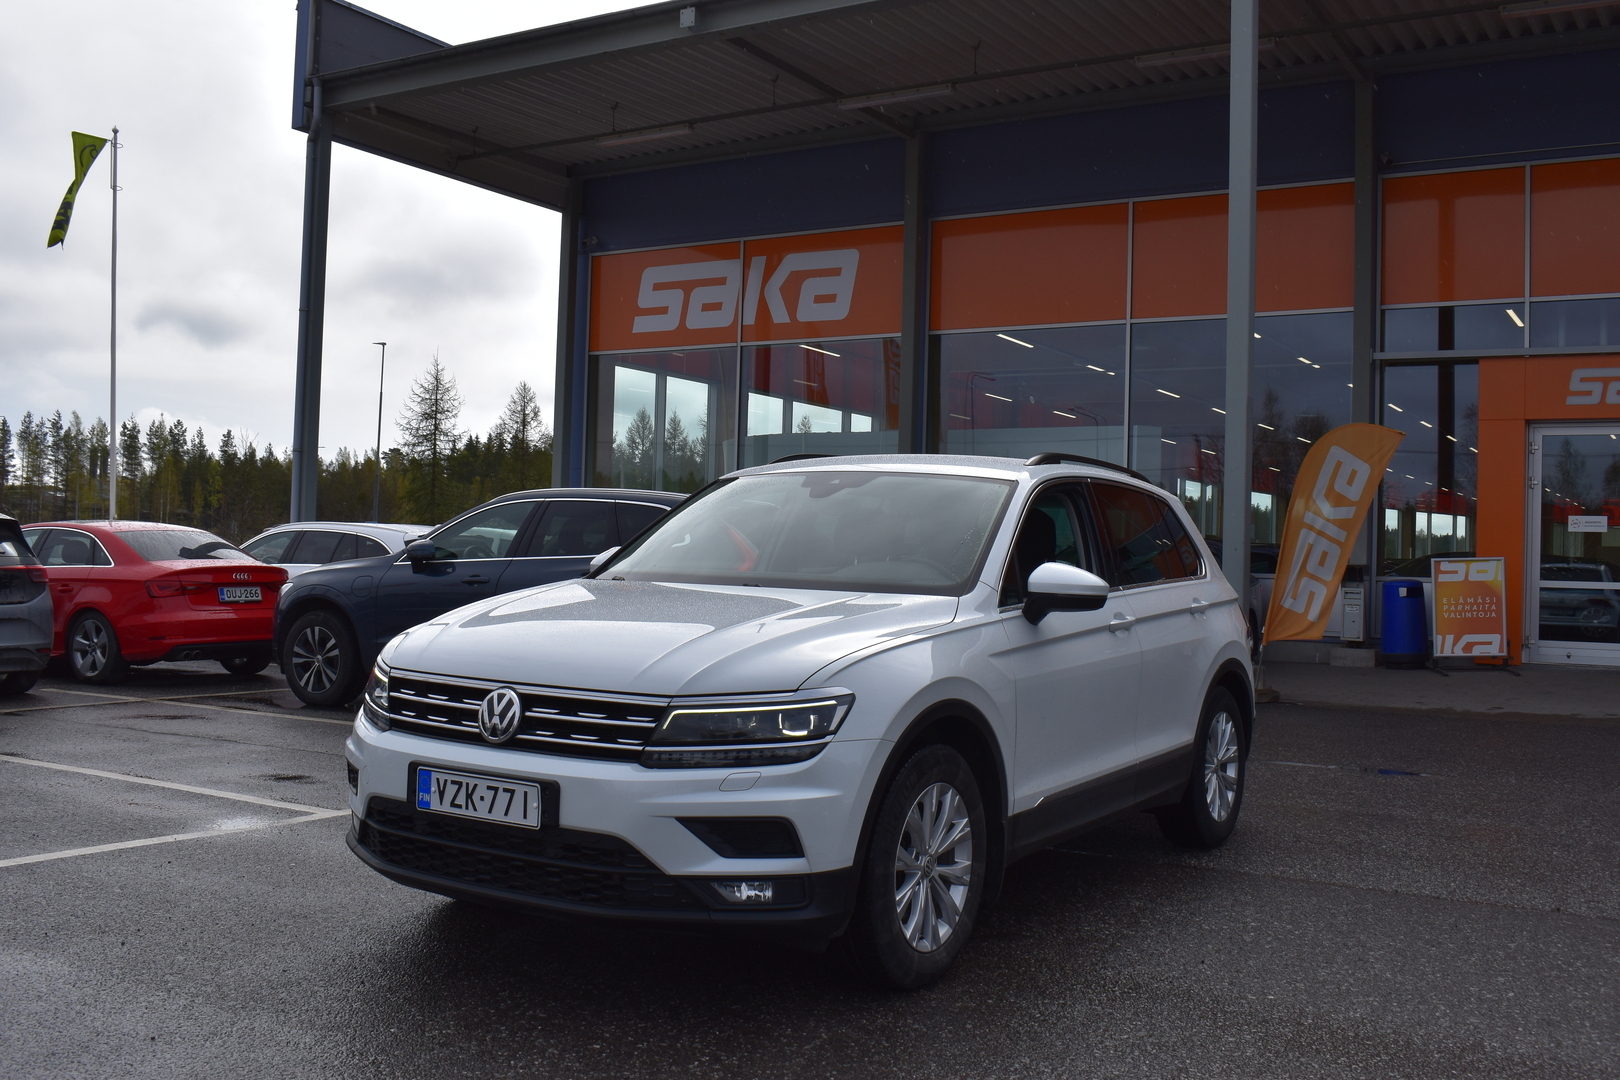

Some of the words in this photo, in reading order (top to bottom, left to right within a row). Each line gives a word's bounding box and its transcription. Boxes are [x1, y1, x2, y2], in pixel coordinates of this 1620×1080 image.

[1437, 561, 1502, 582] sa
[226, 589, 260, 599] OUJ-266
[1443, 596, 1497, 604] ELÄMÄSI
[418, 793, 431, 803] FIN
[435, 776, 529, 820] VZK-771
